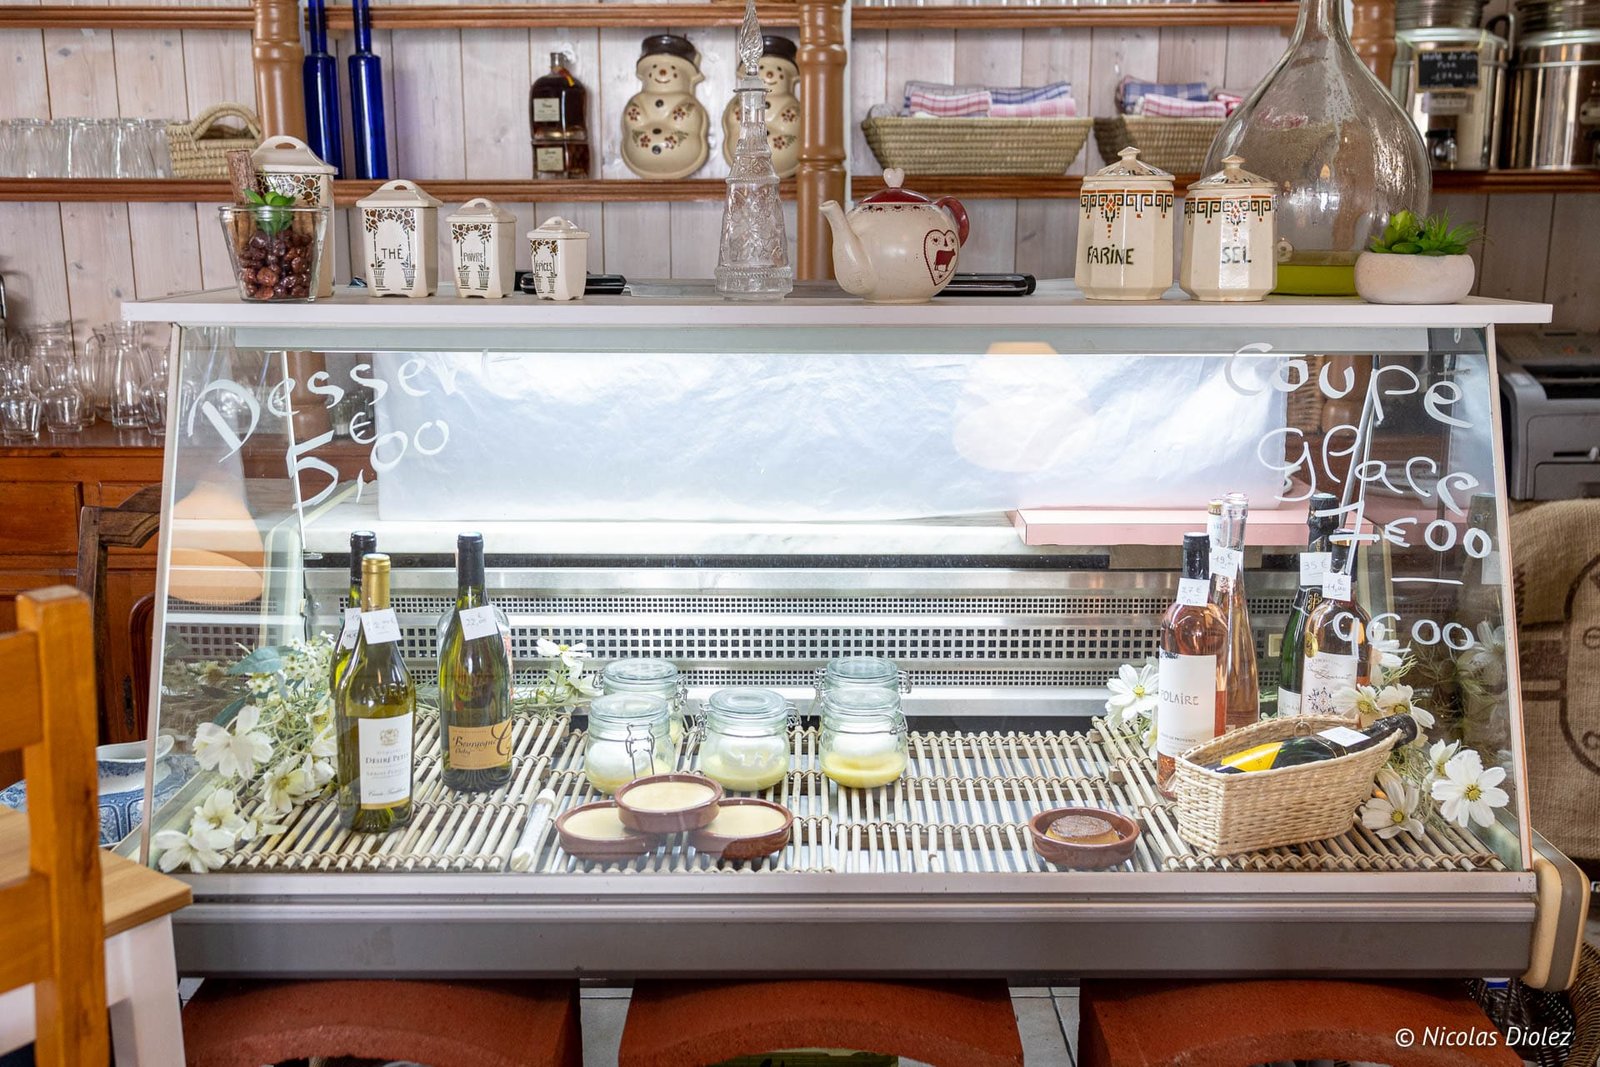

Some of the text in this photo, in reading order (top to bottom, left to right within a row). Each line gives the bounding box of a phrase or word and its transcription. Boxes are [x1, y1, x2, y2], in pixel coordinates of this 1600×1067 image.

[380, 244, 404, 260] THÉ
[1086, 243, 1135, 265] FARINE
[1221, 246, 1252, 264] SEL
[1223, 342, 1474, 428] Coupe
